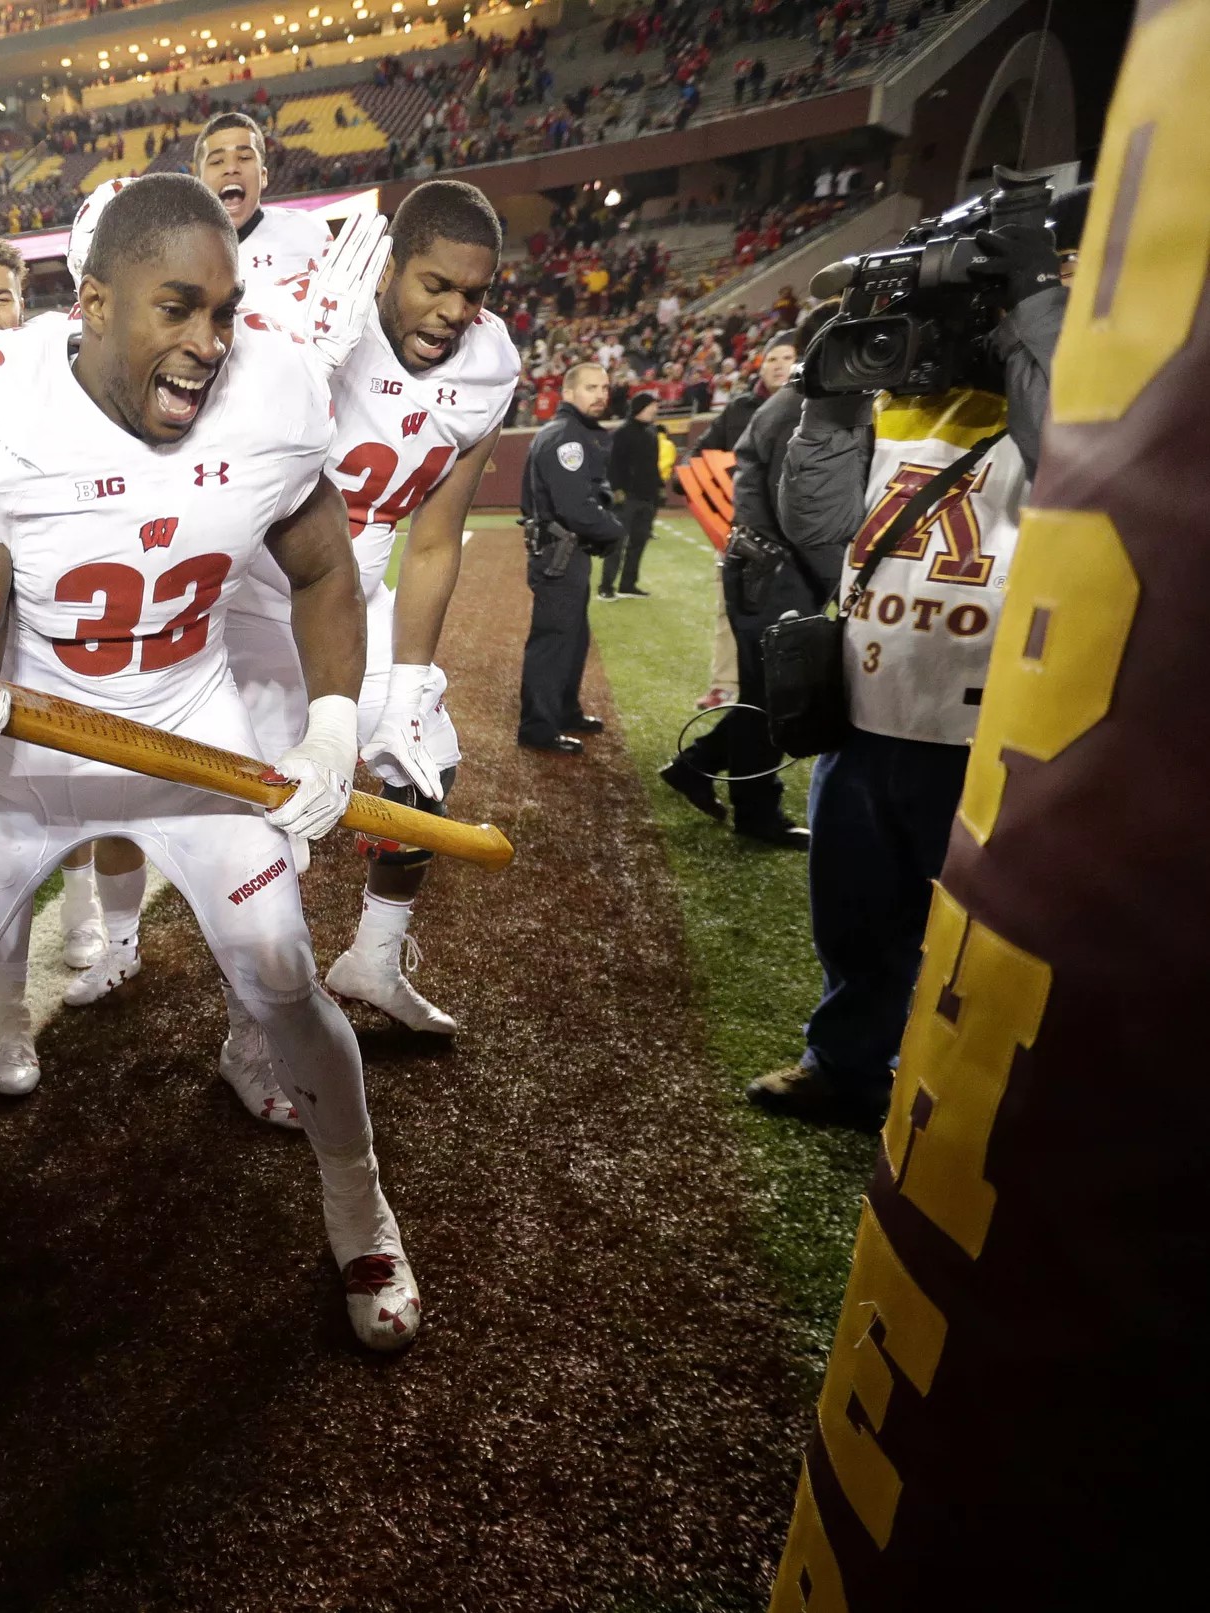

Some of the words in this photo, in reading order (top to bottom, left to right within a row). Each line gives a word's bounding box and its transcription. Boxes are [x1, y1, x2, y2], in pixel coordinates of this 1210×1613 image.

[401, 411, 428, 439] W
[335, 441, 456, 541] 24
[139, 516, 179, 552] W
[50, 552, 233, 677] 32
[850, 587, 990, 638] HOTO
[862, 641, 883, 674] 3
[227, 857, 288, 906] WISCONSIN
